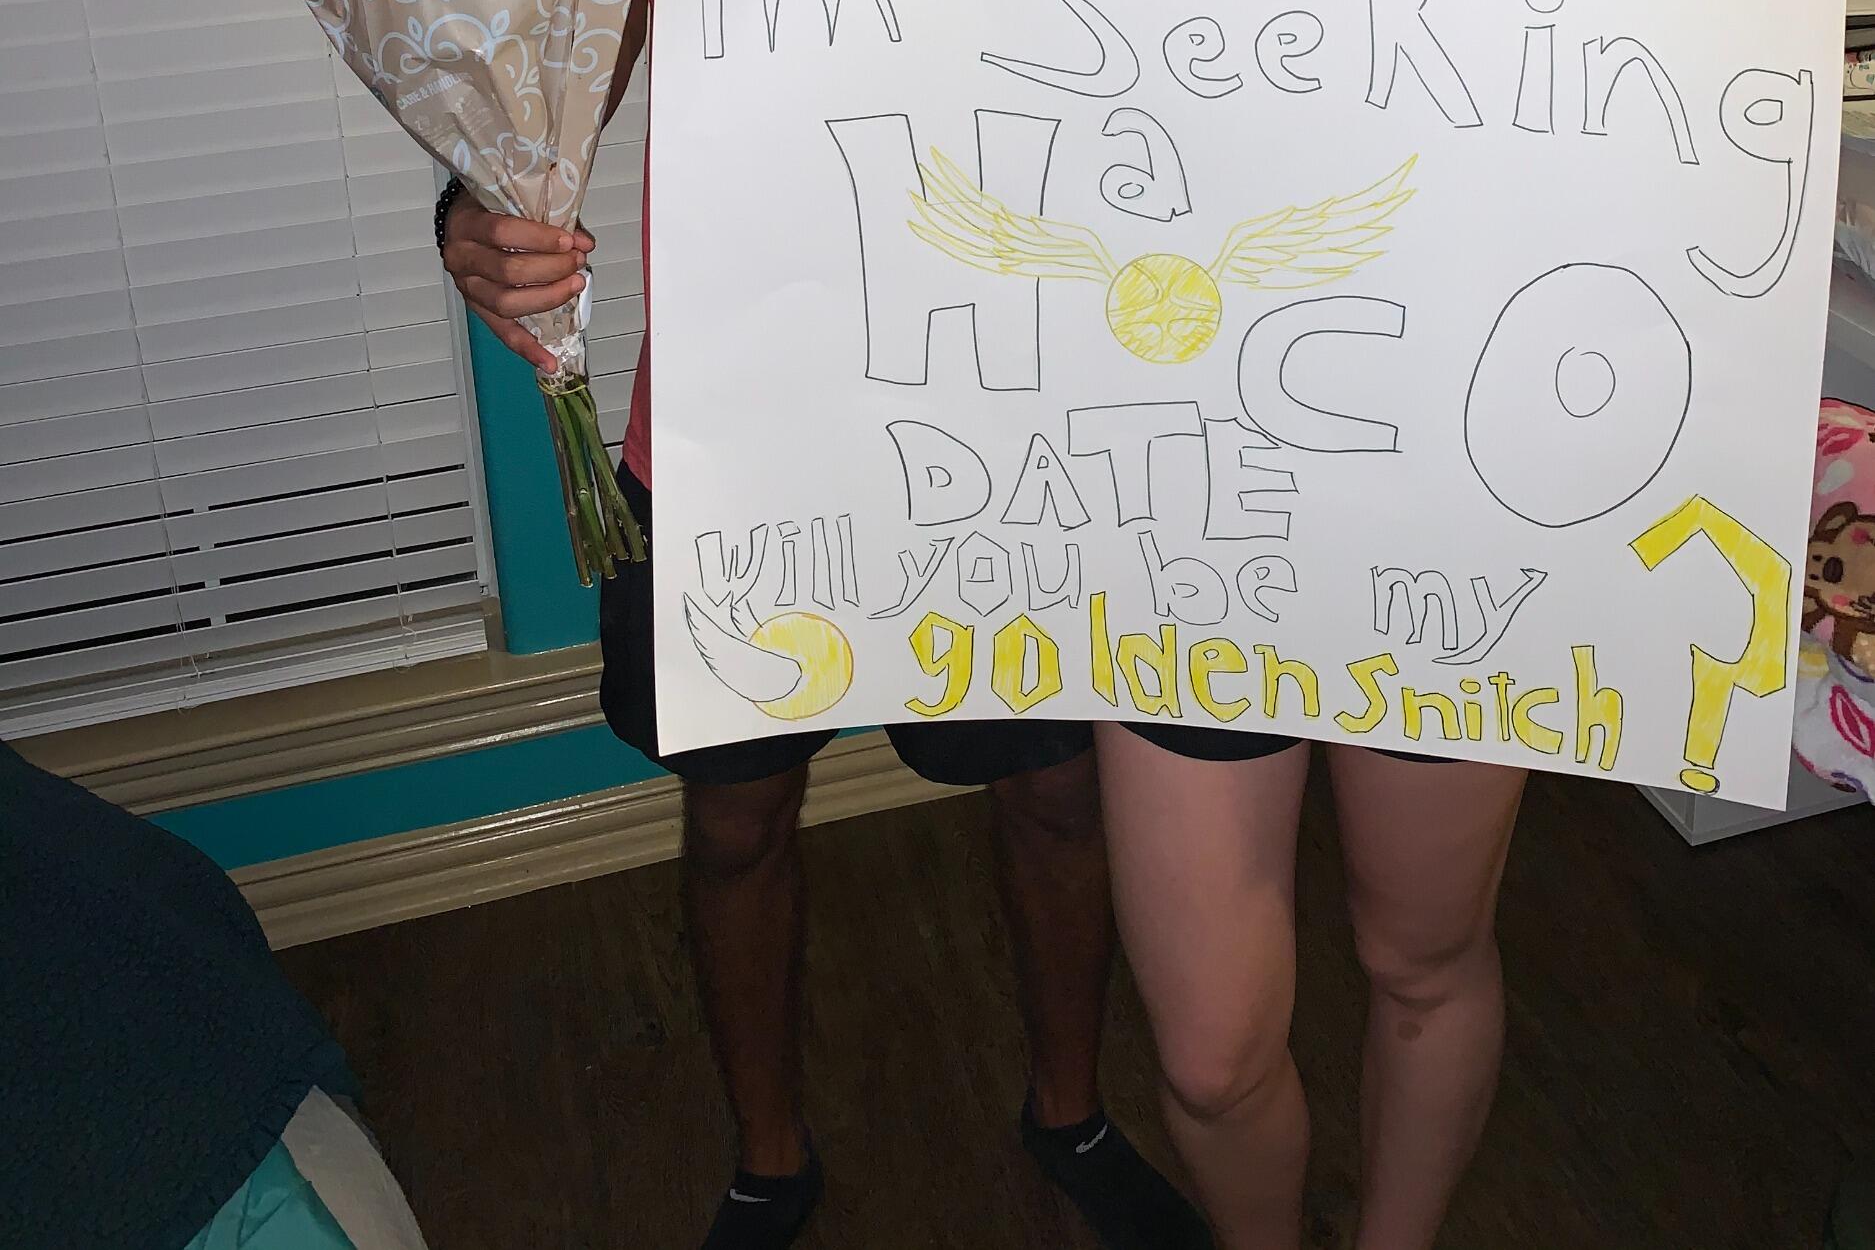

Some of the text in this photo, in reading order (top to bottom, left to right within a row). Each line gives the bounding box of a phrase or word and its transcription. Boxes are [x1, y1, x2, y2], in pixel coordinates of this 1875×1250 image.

[426, 72, 473, 96] HANDLI
[1099, 107, 1192, 223] a
[886, 400, 1300, 541] DATE
[867, 530, 1082, 620] you
[1137, 530, 1299, 626] be
[1370, 565, 1549, 666] my
[904, 591, 1321, 723] golden
